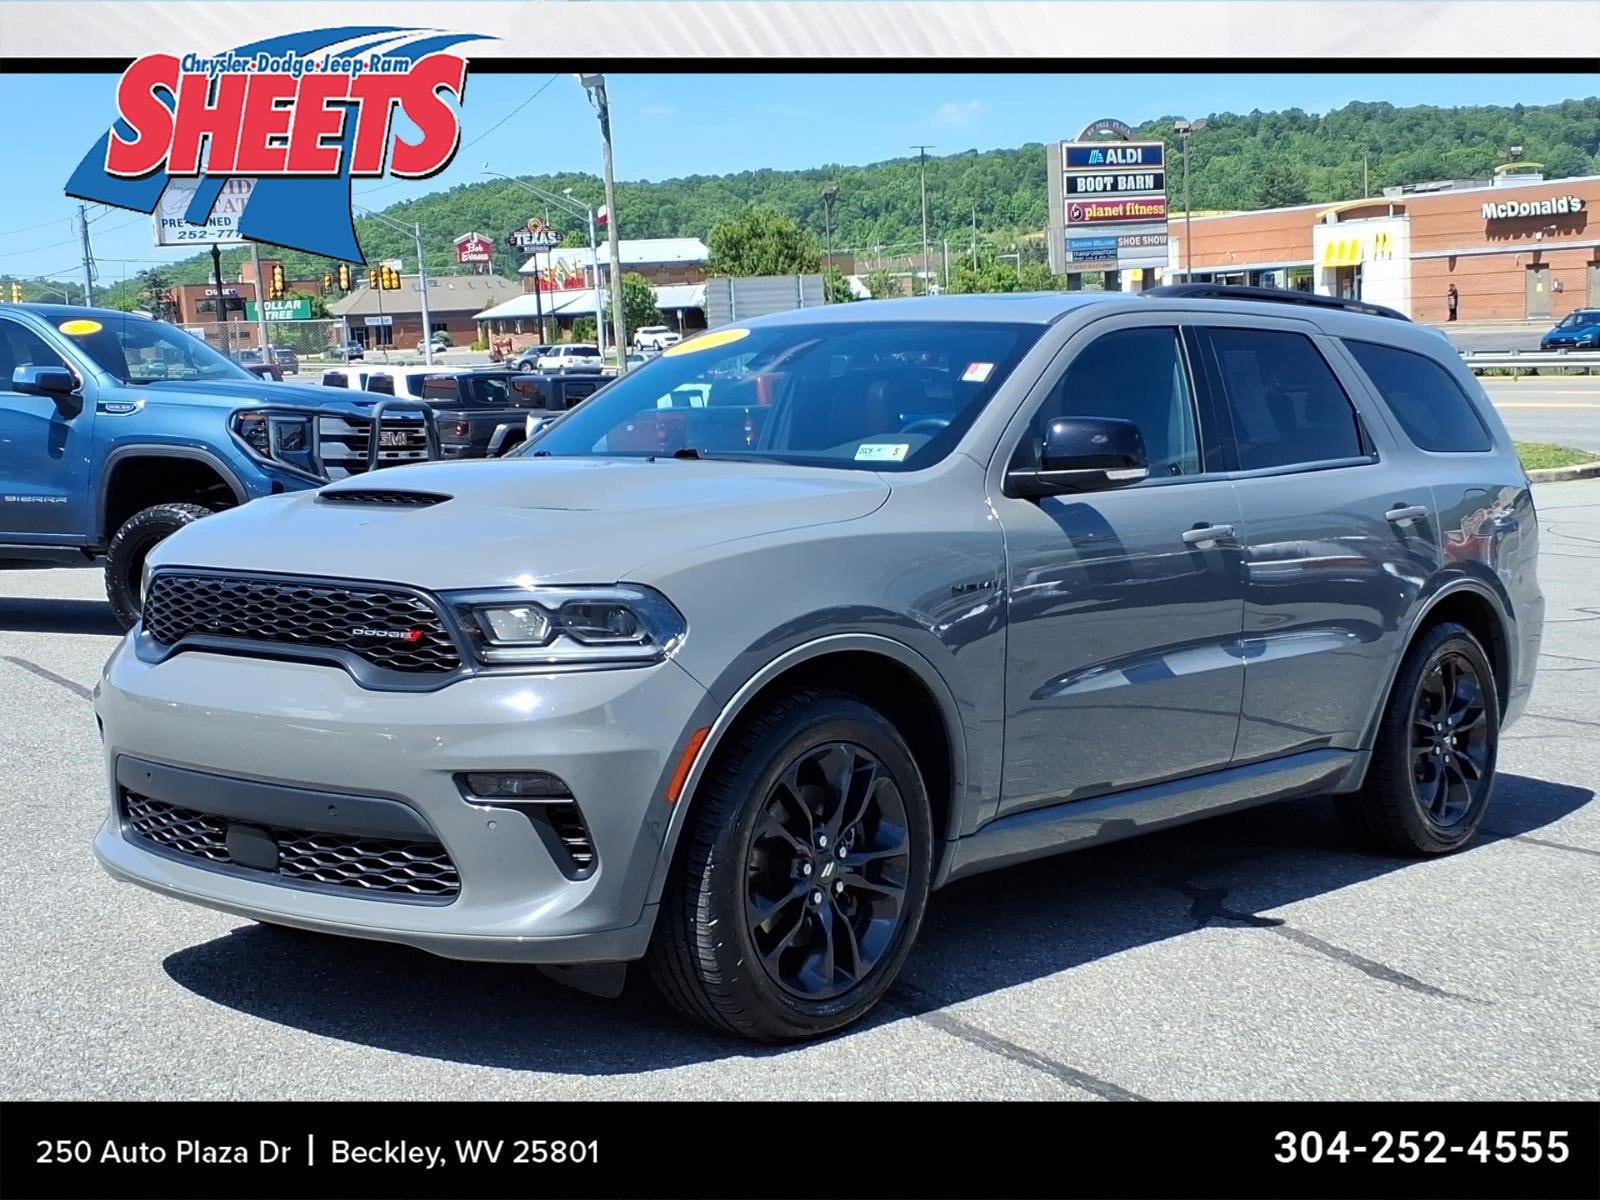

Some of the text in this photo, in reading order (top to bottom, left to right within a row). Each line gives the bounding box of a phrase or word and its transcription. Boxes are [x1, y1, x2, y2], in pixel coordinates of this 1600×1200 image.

[1105, 148, 1142, 164] ALDI
[1077, 175, 1154, 192] BOOT BARN
[1084, 202, 1165, 221] planet fitness
[1481, 195, 1582, 219] McDonald's
[513, 231, 557, 245] TEXAS
[1118, 234, 1167, 247] SHOE SHOW
[265, 310, 294, 320] TREE
[352, 628, 412, 642] DODGE
